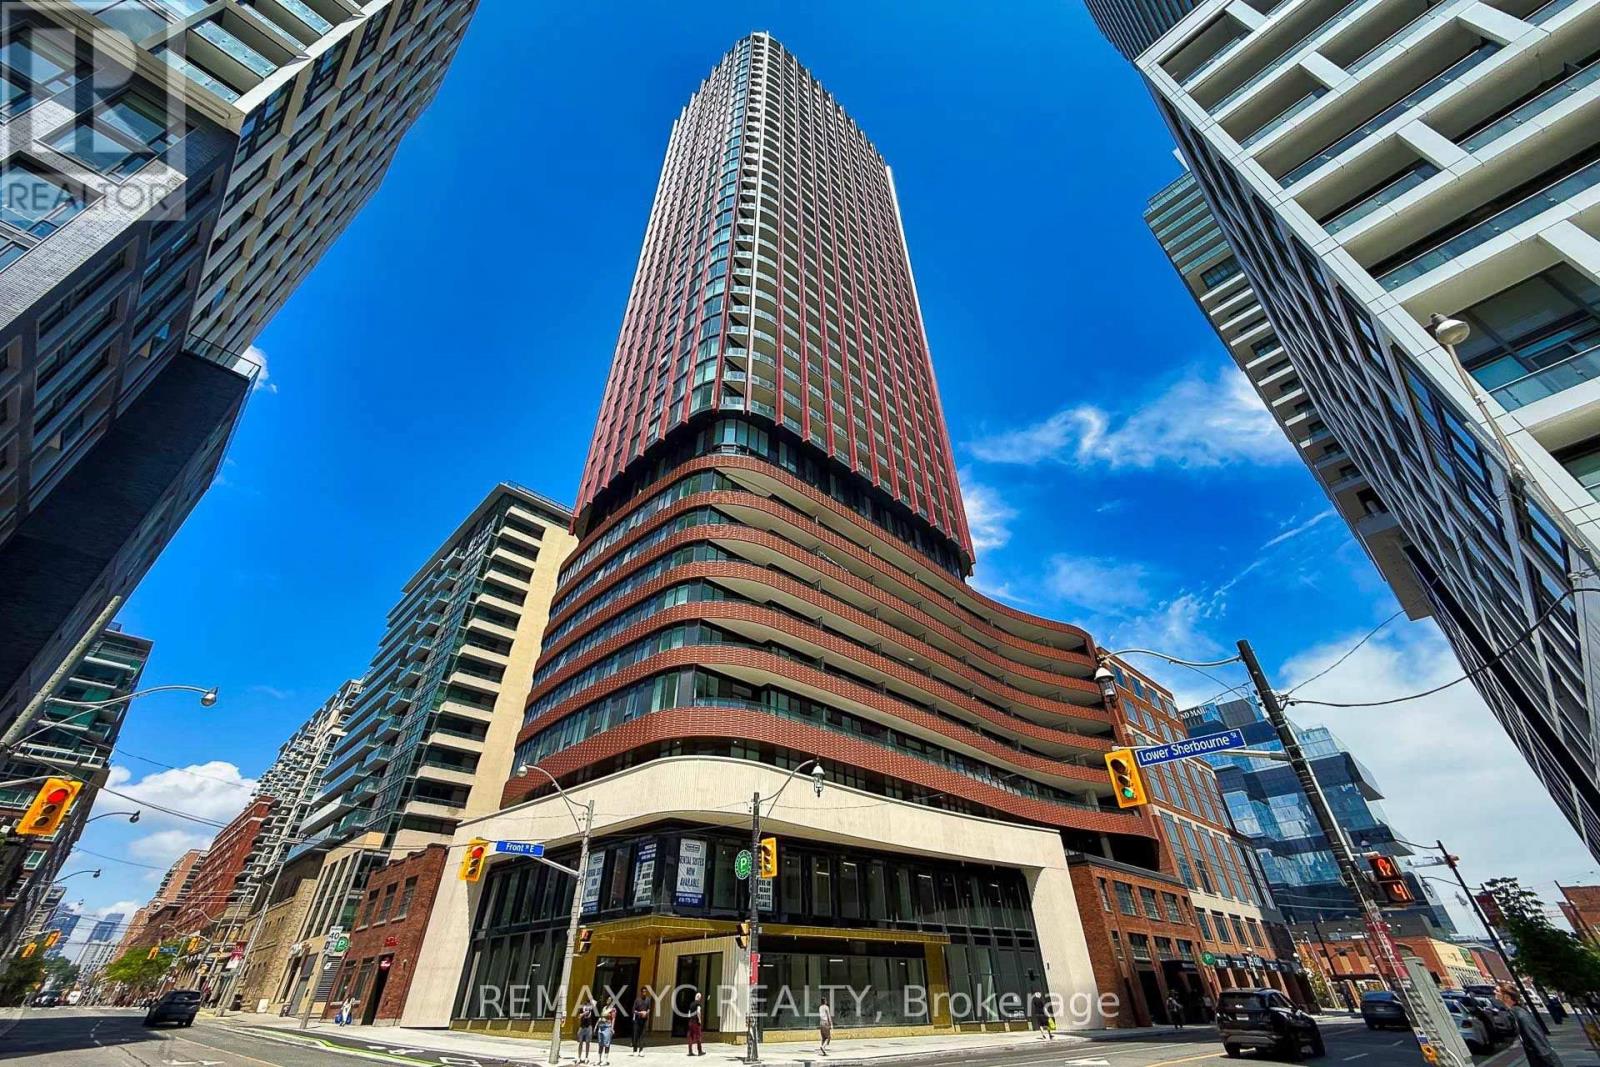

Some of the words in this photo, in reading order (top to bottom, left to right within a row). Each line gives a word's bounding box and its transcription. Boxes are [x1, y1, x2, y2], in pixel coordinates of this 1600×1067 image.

[1140, 747, 1170, 762] Lower
[1171, 736, 1230, 756] Sherbourne
[506, 842, 524, 852] Front
[530, 845, 535, 853] E
[1393, 884, 1408, 900] 4
